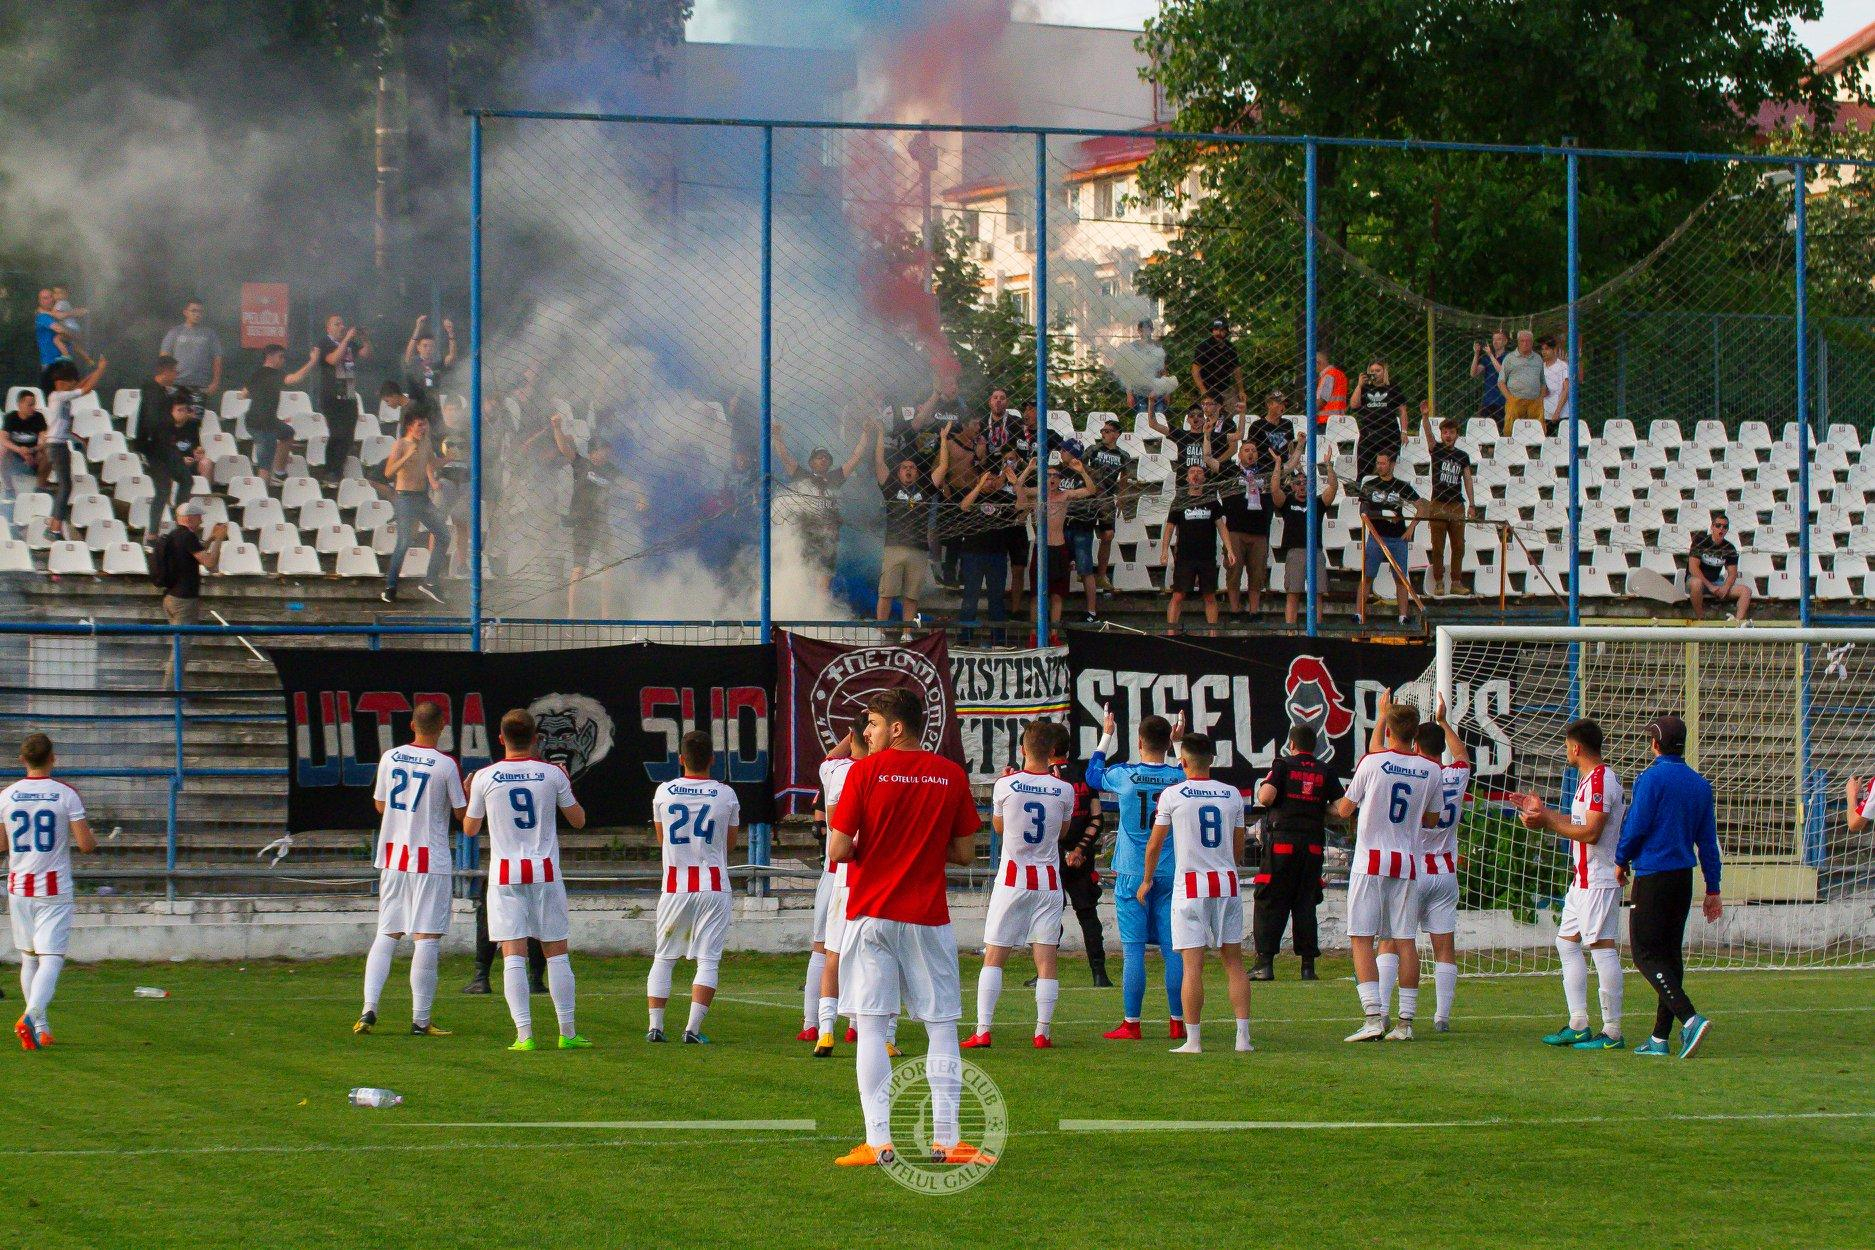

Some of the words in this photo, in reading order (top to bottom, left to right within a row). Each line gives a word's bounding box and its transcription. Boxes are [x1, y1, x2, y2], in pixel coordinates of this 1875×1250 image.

[640, 686, 769, 782] SUD
[1077, 668, 1276, 768] STEEL
[1350, 679, 1512, 776] BYS
[390, 768, 431, 812] 27
[878, 774, 889, 783] SC
[891, 774, 920, 783] OTELUL
[921, 775, 949, 786] GALATI
[1388, 781, 1413, 823] 6
[508, 786, 537, 830] 9
[668, 803, 716, 845] 24
[1023, 802, 1047, 844] 3
[1198, 804, 1222, 848] 8
[10, 808, 56, 853] 28
